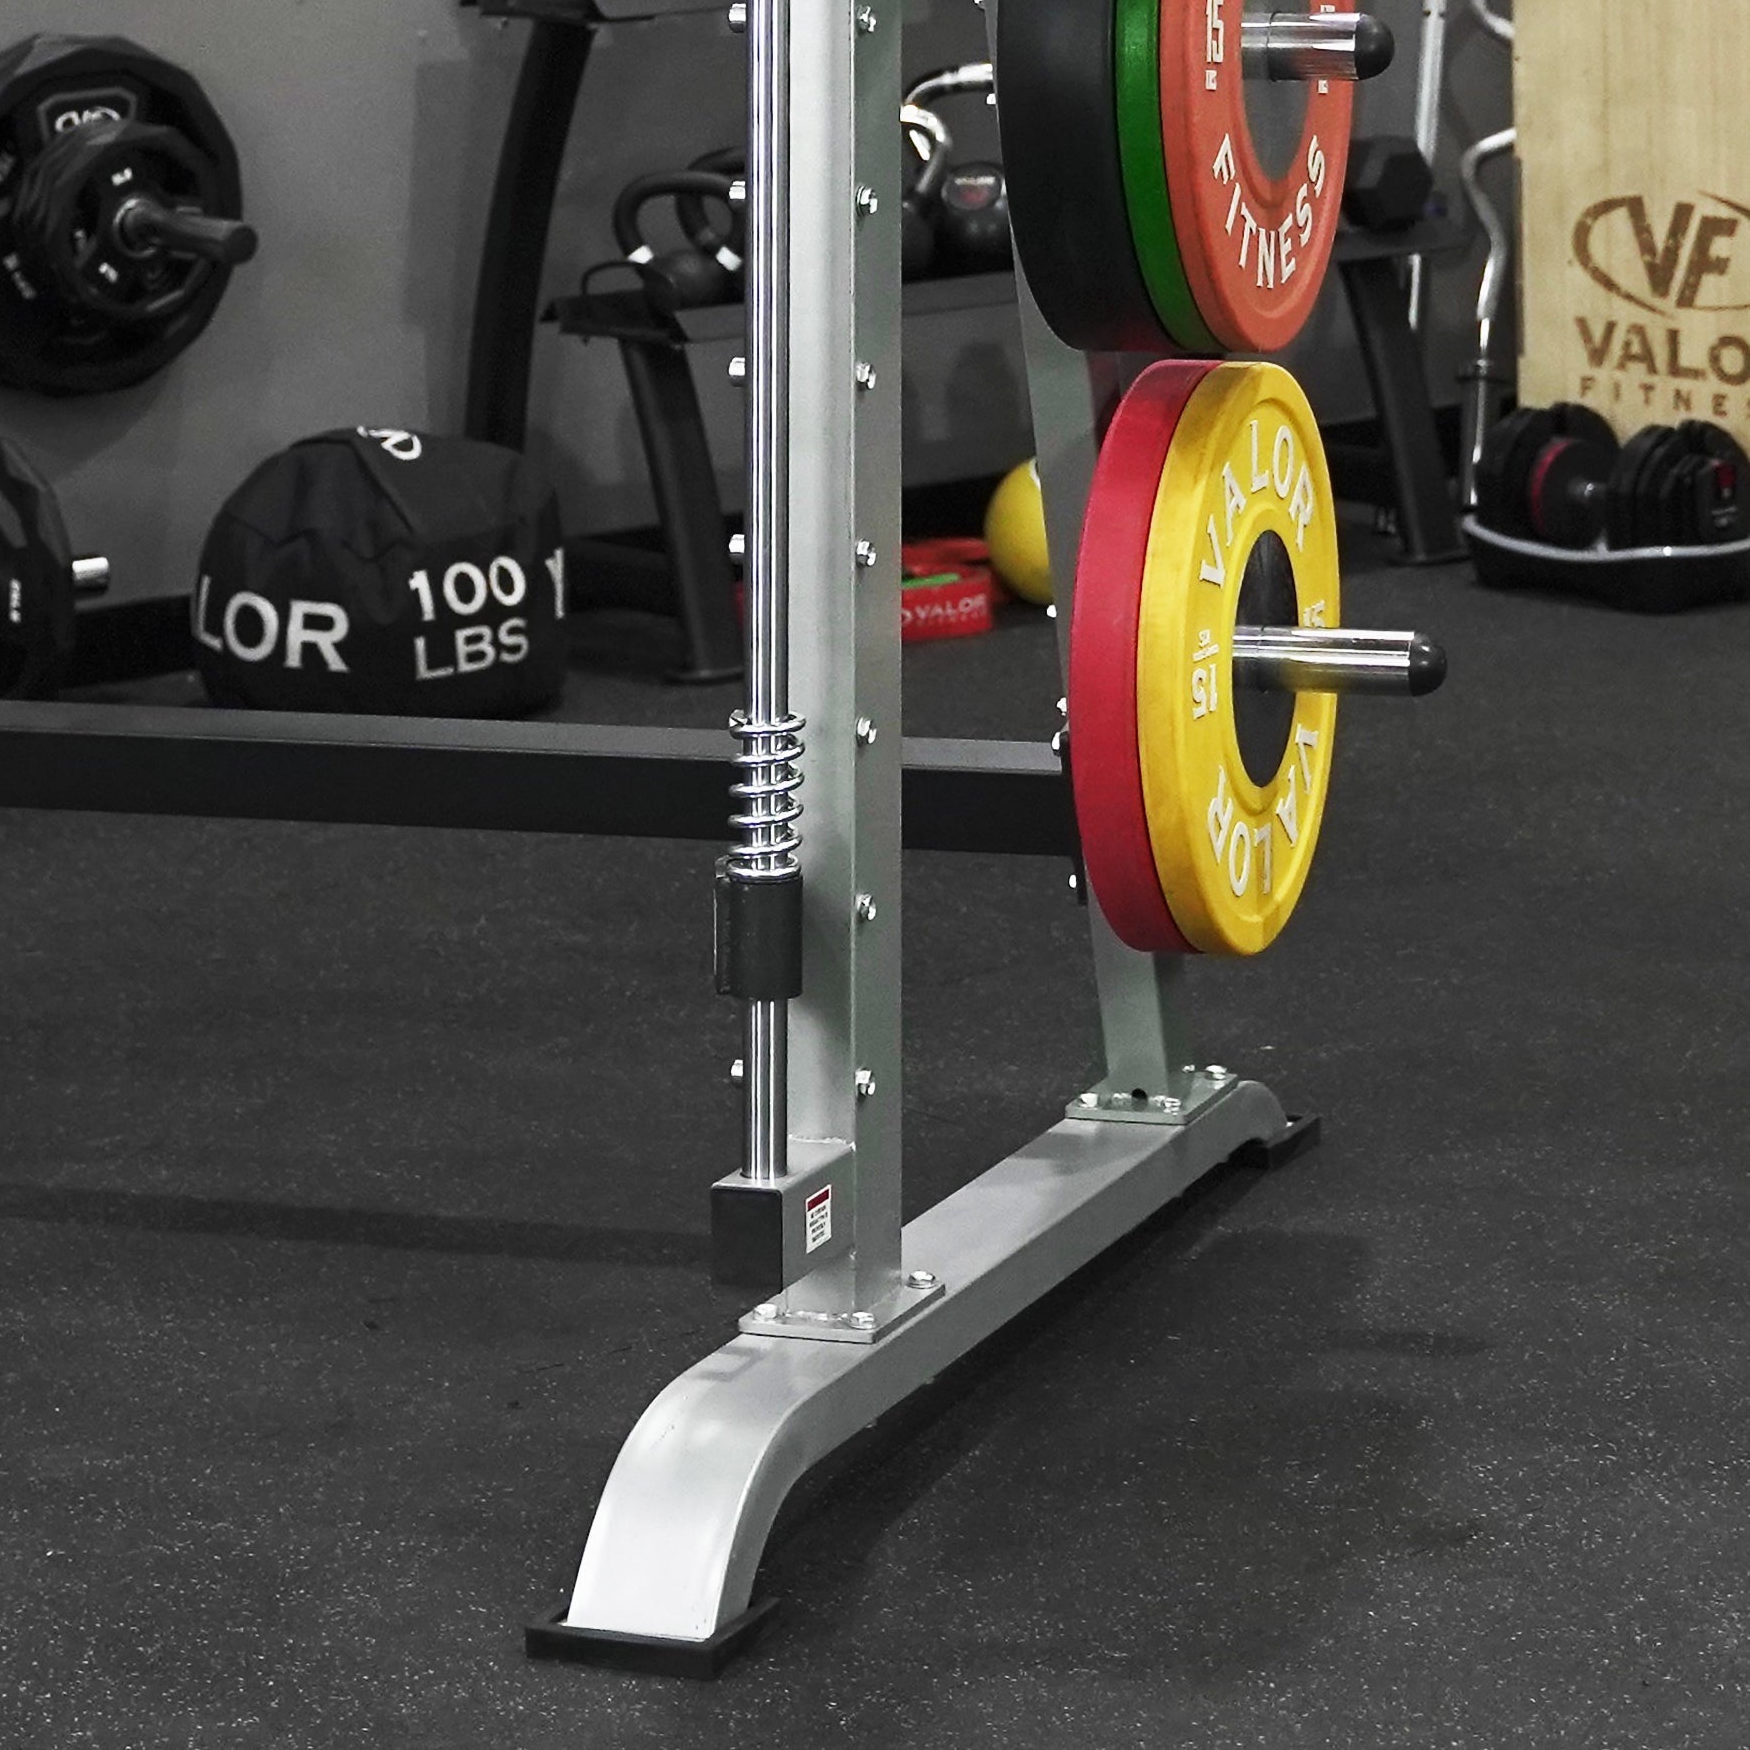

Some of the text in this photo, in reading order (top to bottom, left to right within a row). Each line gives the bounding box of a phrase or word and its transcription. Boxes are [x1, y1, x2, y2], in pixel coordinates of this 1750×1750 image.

[1212, 132, 1326, 290] FITNESS
[1574, 315, 1750, 386] VALO
[1579, 376, 1750, 417] FITNE
[1200, 420, 1315, 588] VALOR
[199, 575, 349, 673] LOR
[408, 556, 527, 622] 100
[415, 617, 529, 680] LBS
[1192, 664, 1217, 720] 15
[1207, 724, 1318, 897] VALOR
